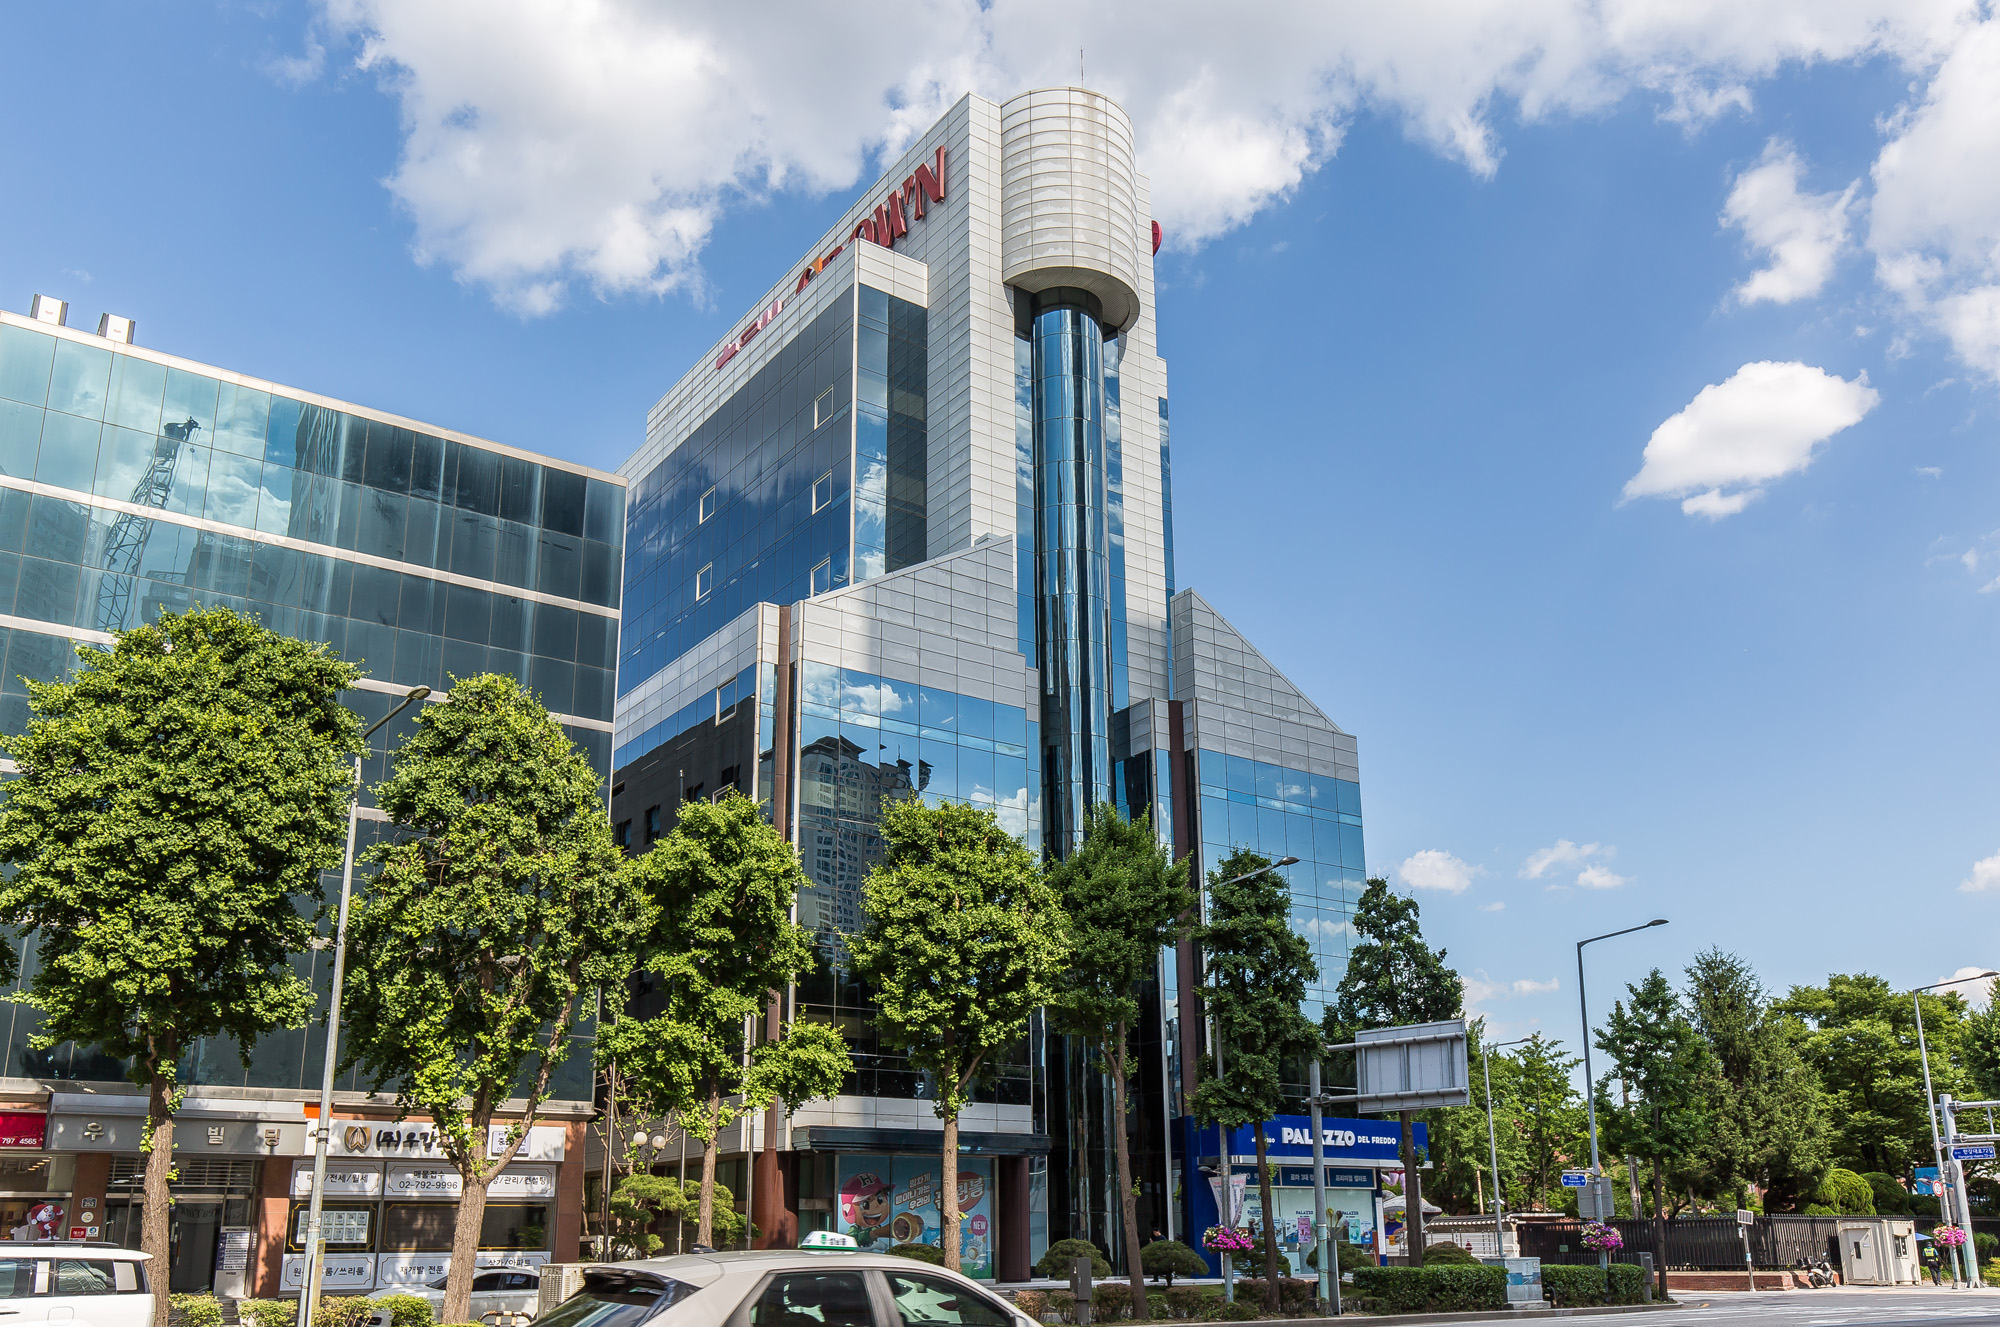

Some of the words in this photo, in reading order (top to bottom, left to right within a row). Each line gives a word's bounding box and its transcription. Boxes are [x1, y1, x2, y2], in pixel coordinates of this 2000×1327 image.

[1282, 1127, 1355, 1147] PALZZO
[1357, 1135, 1370, 1143] DEL
[1371, 1136, 1396, 1145] FREDDO
[307, 1173, 368, 1183] /전세/월세
[413, 1170, 445, 1179] 매물접수
[399, 1181, 457, 1189] 02-792-9996
[859, 1174, 874, 1187] H
[909, 1194, 931, 1209] 우리의
[973, 1221, 986, 1230] NEW
[293, 1267, 365, 1277] 원룸/쓰리룸
[400, 1265, 424, 1275] 재개발
[428, 1265, 444, 1275] 전문
